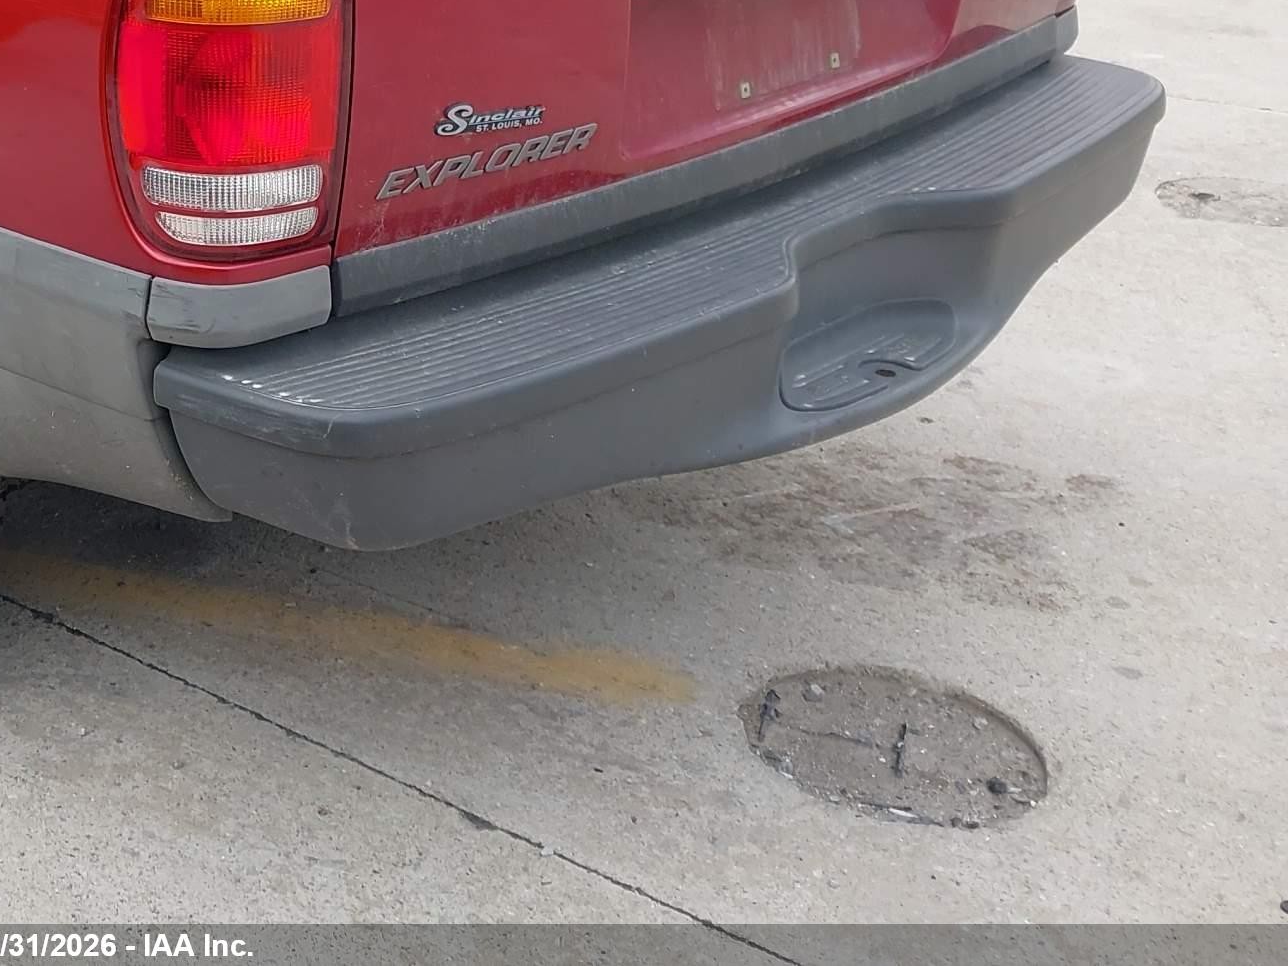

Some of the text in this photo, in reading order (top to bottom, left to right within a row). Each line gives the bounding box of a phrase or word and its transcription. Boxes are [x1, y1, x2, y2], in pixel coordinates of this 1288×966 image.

[436, 104, 546, 136] Sinclair
[475, 117, 543, 133] ST. LOUIS, MO.
[376, 123, 597, 200] EXPLORER
